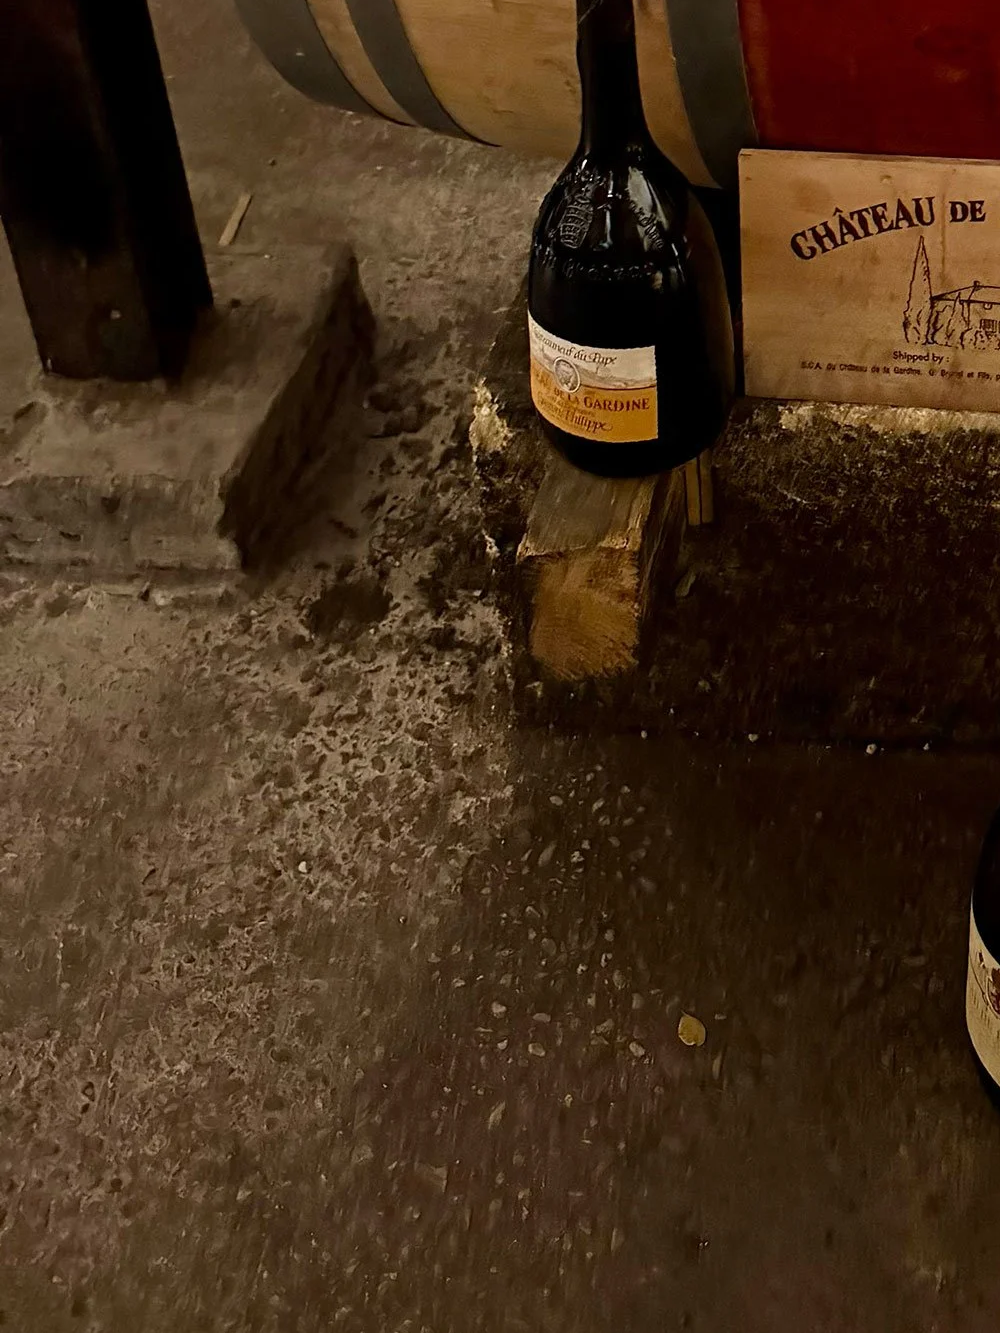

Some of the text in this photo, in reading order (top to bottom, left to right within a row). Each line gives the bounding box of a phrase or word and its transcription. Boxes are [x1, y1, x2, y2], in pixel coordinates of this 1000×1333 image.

[790, 196, 936, 261] CHÂTEAU
[949, 200, 986, 224] DE
[893, 351, 930, 363] Shipped
[932, 353, 944, 365] by
[826, 362, 836, 371] du
[871, 365, 880, 373] de
[882, 365, 890, 374] la
[583, 396, 651, 412] GARDINE
